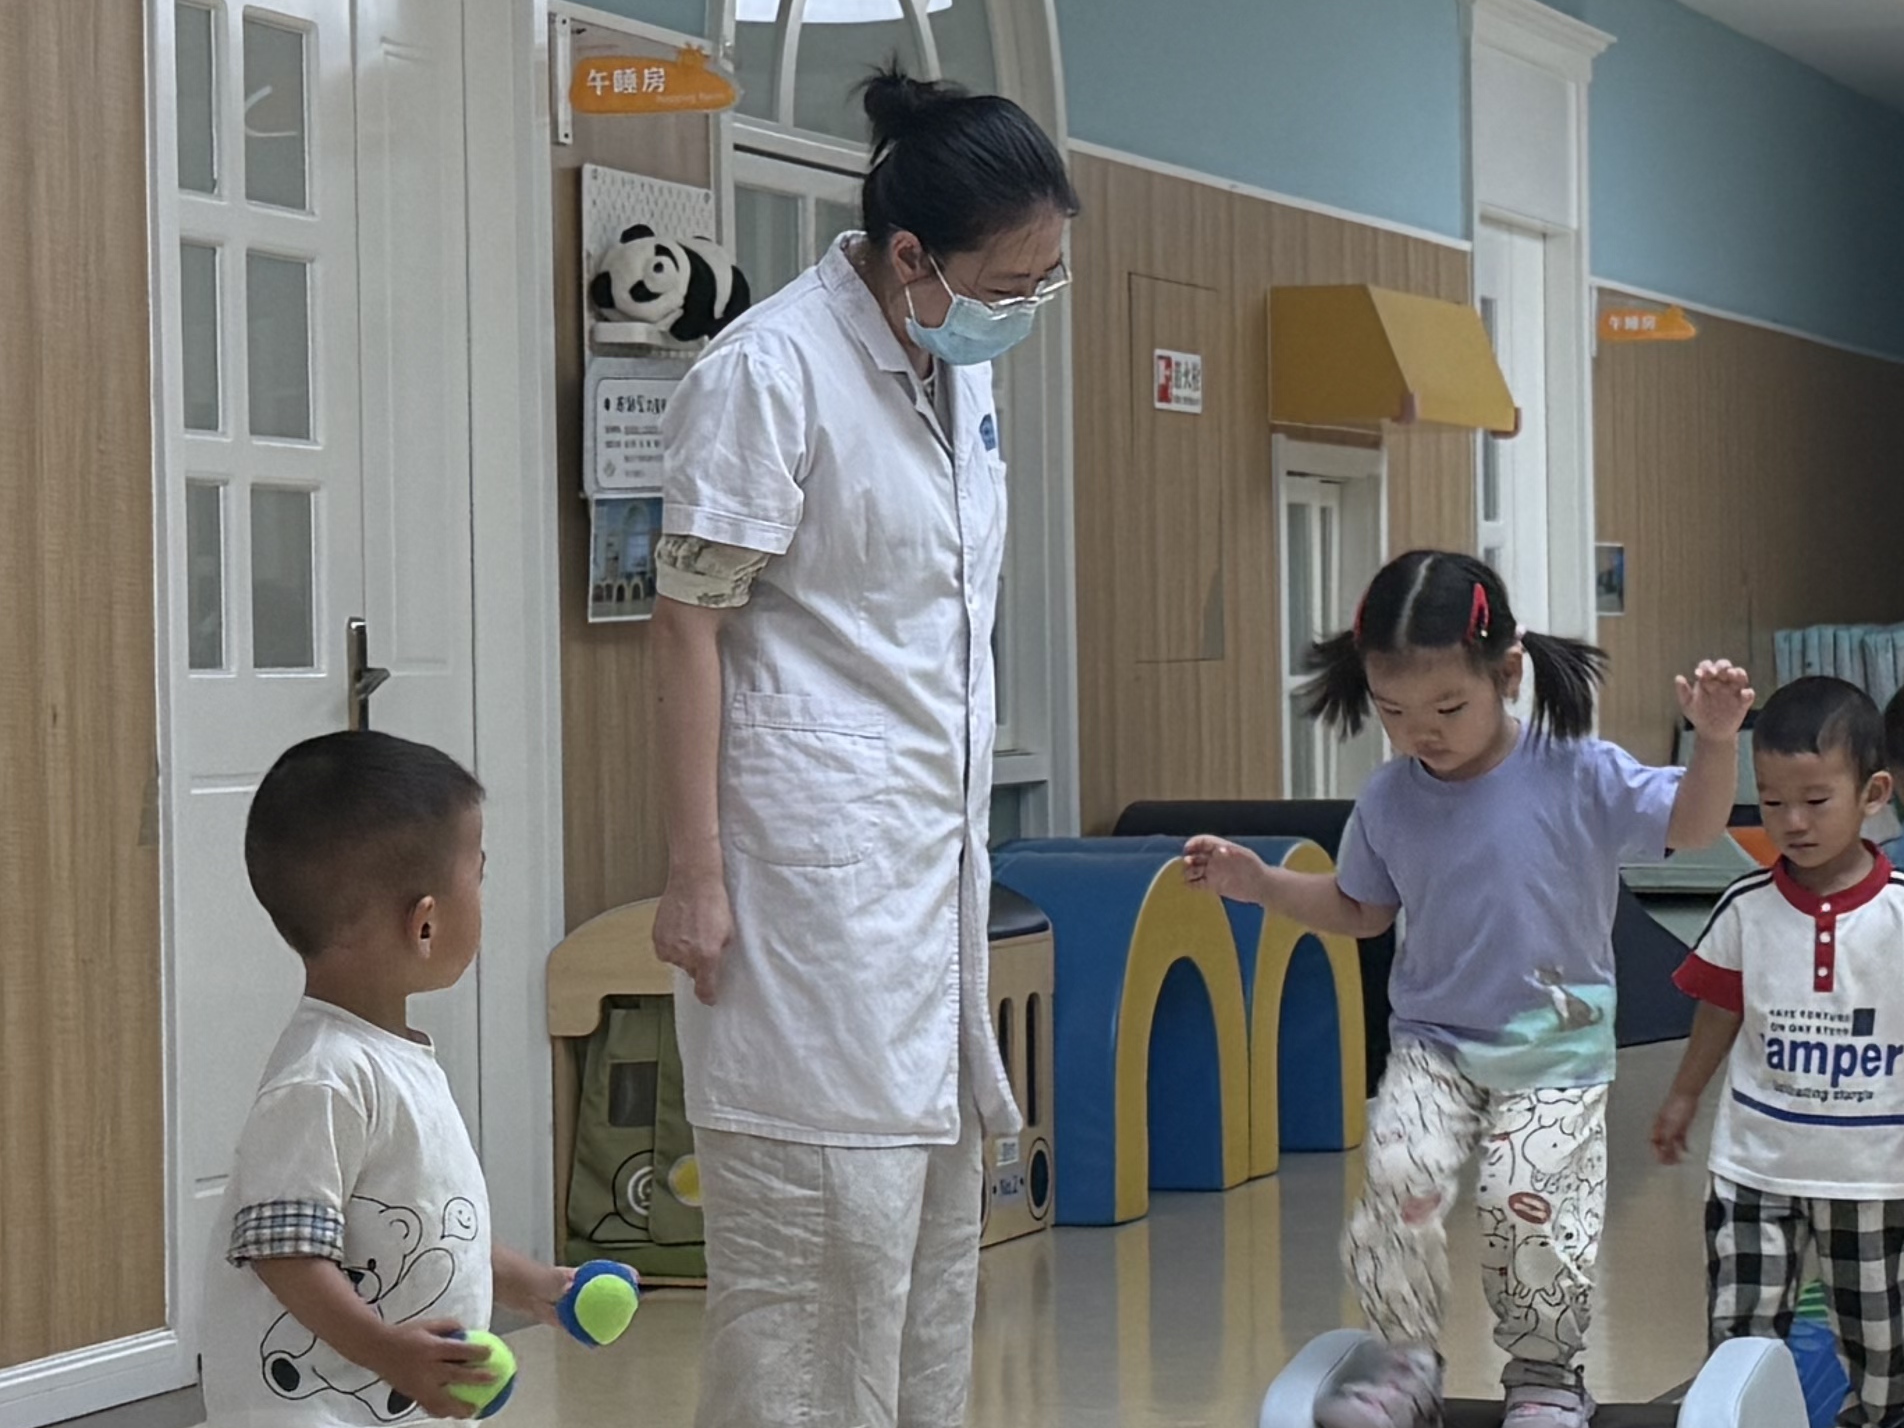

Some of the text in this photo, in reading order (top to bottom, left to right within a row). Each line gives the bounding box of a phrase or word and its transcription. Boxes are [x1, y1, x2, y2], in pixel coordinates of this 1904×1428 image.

[586, 67, 665, 96] 午睡房
[1760, 1033, 1904, 1088] amper
